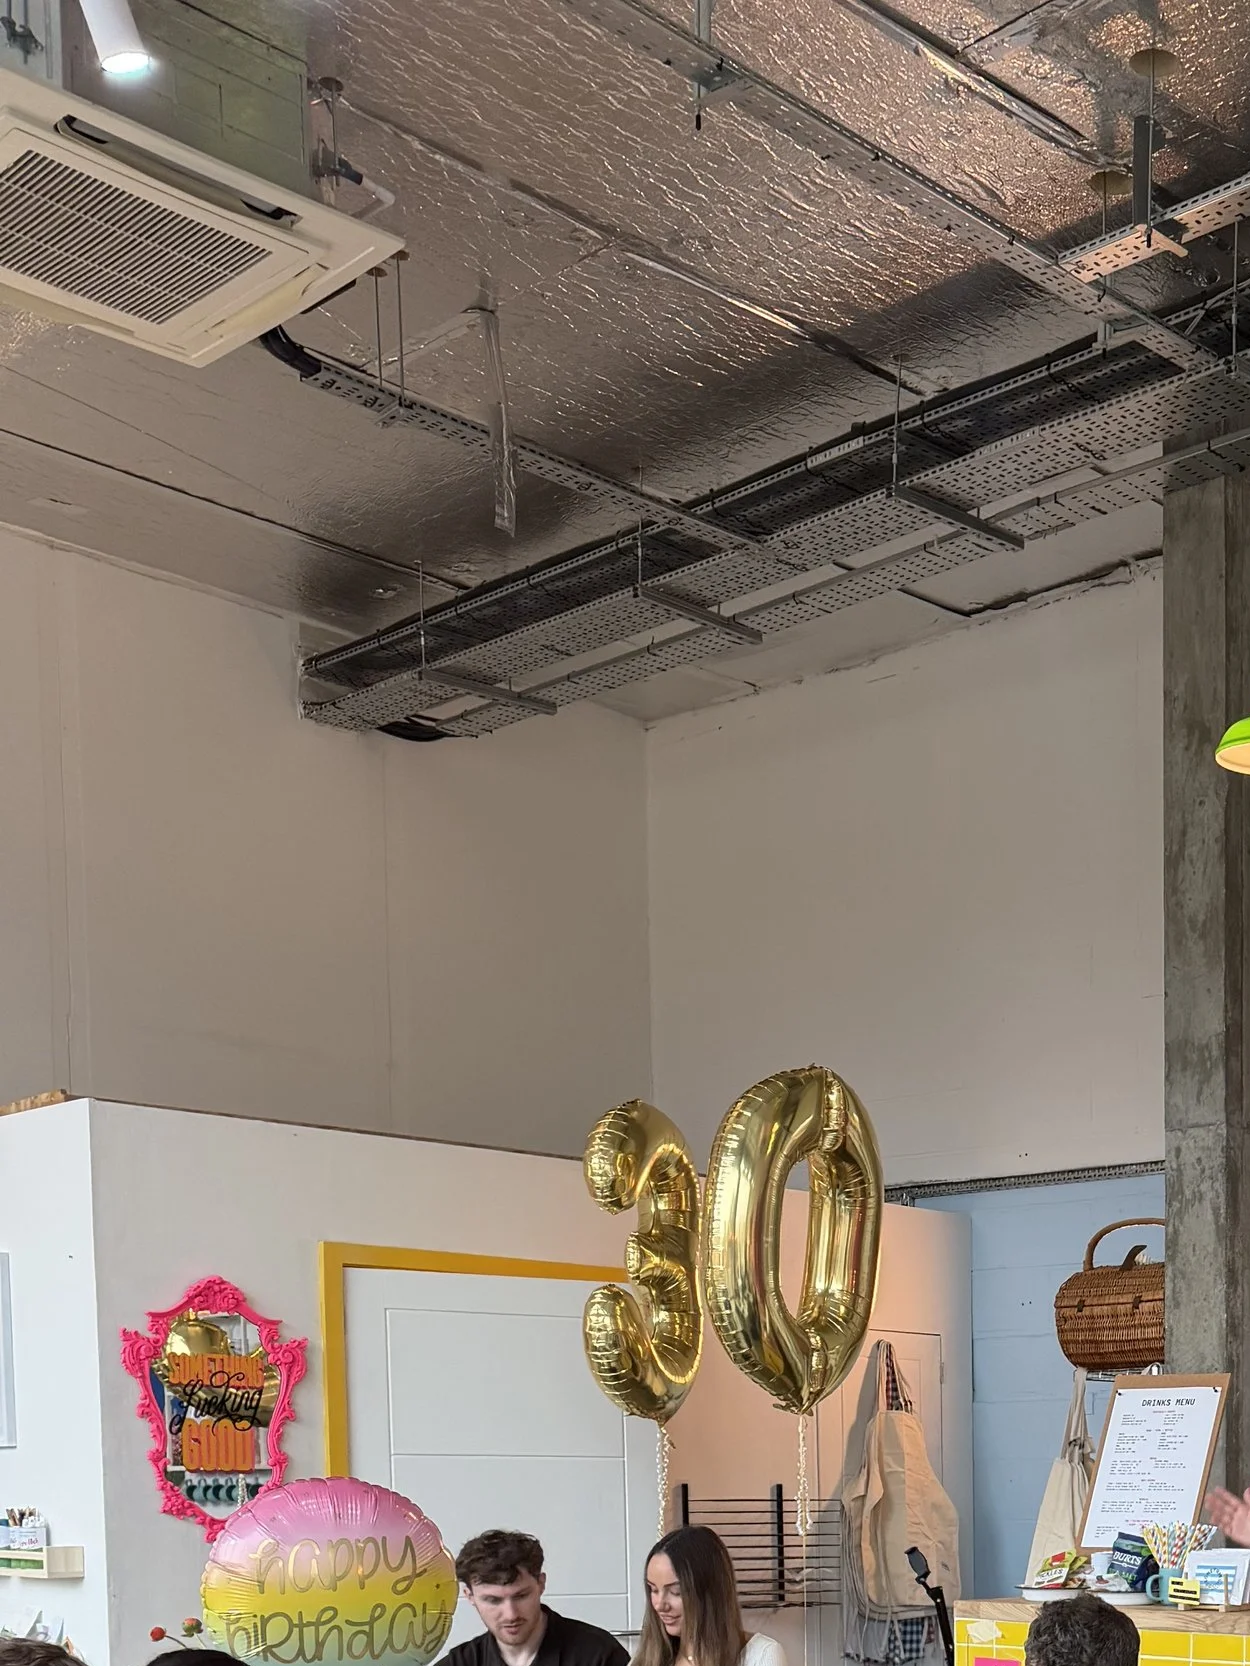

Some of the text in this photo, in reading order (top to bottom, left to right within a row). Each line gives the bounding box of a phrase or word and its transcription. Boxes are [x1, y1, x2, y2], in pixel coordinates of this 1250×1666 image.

[168, 1352, 265, 1389] SOMETHING
[1142, 1399, 1172, 1407] DRINKS
[182, 1418, 256, 1473] GOOD
